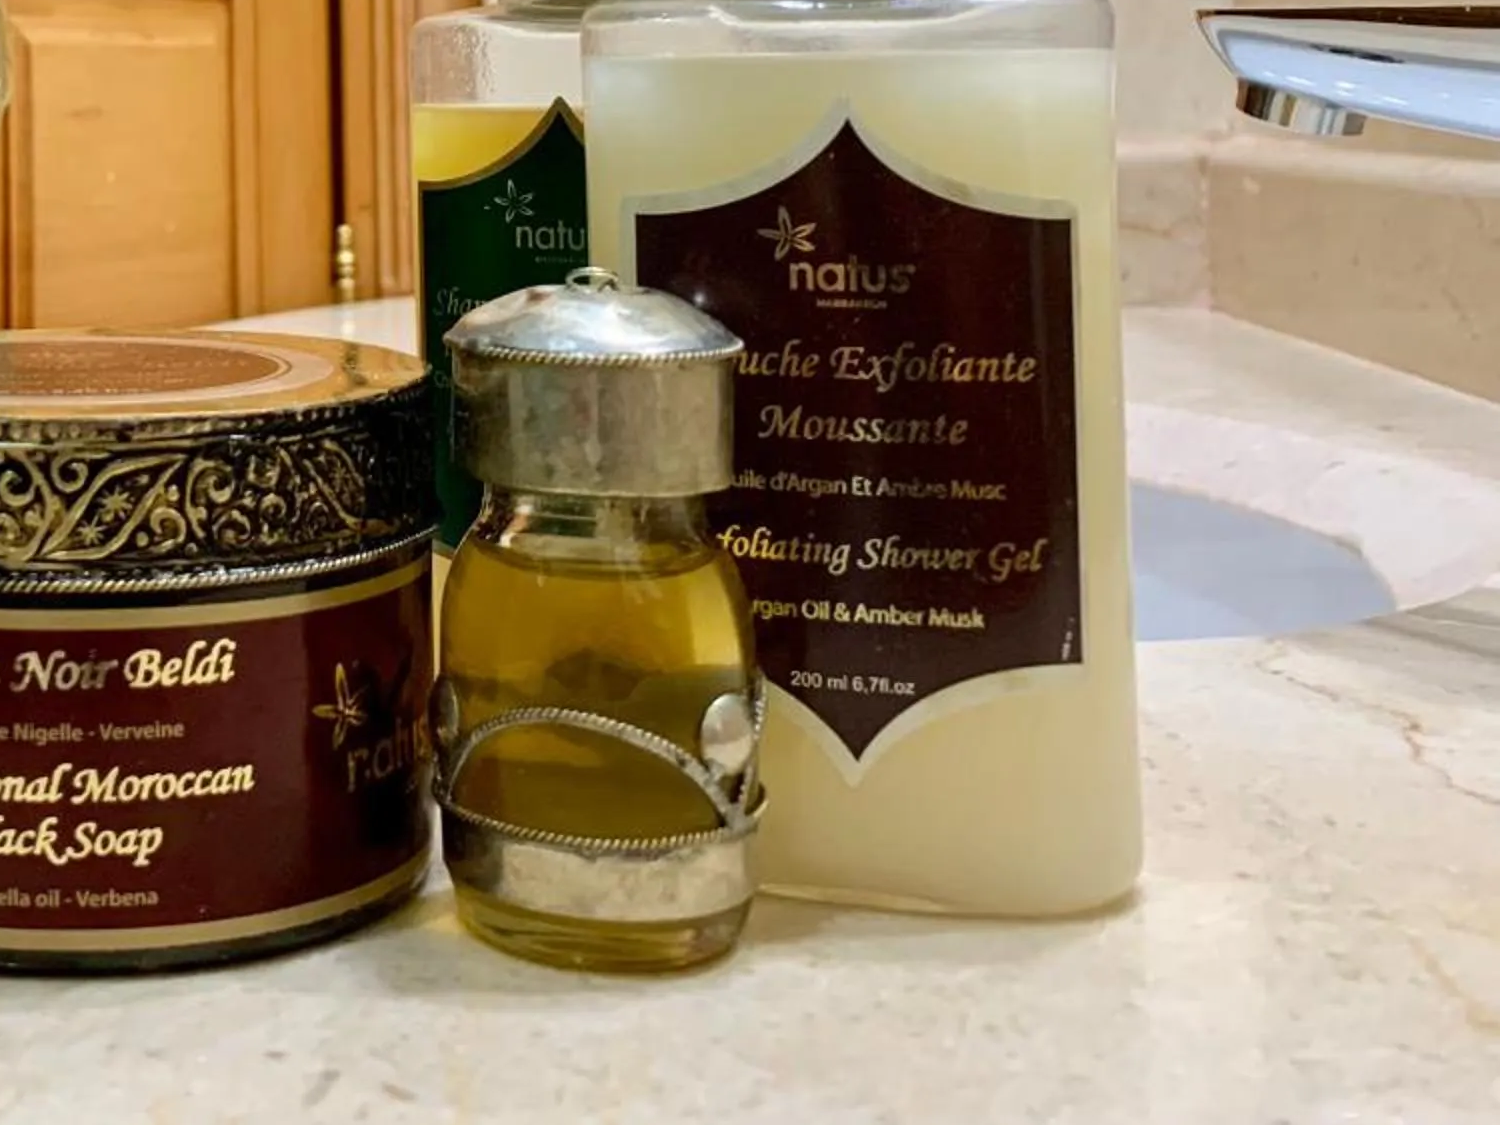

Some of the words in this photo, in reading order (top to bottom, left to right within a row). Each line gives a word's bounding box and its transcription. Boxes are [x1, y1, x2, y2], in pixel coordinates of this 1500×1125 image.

[515, 220, 586, 251] natu
[788, 254, 915, 294] natus
[732, 339, 820, 376] uche
[829, 341, 1037, 394] Exfoliante
[757, 404, 969, 445] Moussante
[730, 468, 766, 490] uile
[769, 471, 847, 499] d'Argan
[851, 475, 873, 496] Et
[951, 479, 1008, 501] Musc
[715, 524, 851, 575] foliating
[855, 534, 983, 571] Shower
[985, 537, 1048, 583] Gel
[752, 598, 798, 620] rgan
[801, 598, 830, 619] Oil
[833, 601, 850, 622] &
[853, 603, 924, 625] Amber
[927, 607, 986, 629] Musk
[8, 648, 119, 693] Noir
[123, 637, 237, 689] Beldi
[790, 669, 823, 689] 200
[827, 672, 848, 690] ml
[13, 720, 84, 747] Nigelle
[99, 719, 185, 742] Verveine
[69, 762, 255, 805] Moroccan
[64, 820, 164, 868] Soap
[35, 886, 60, 908] oil
[76, 887, 160, 908] Verbena
